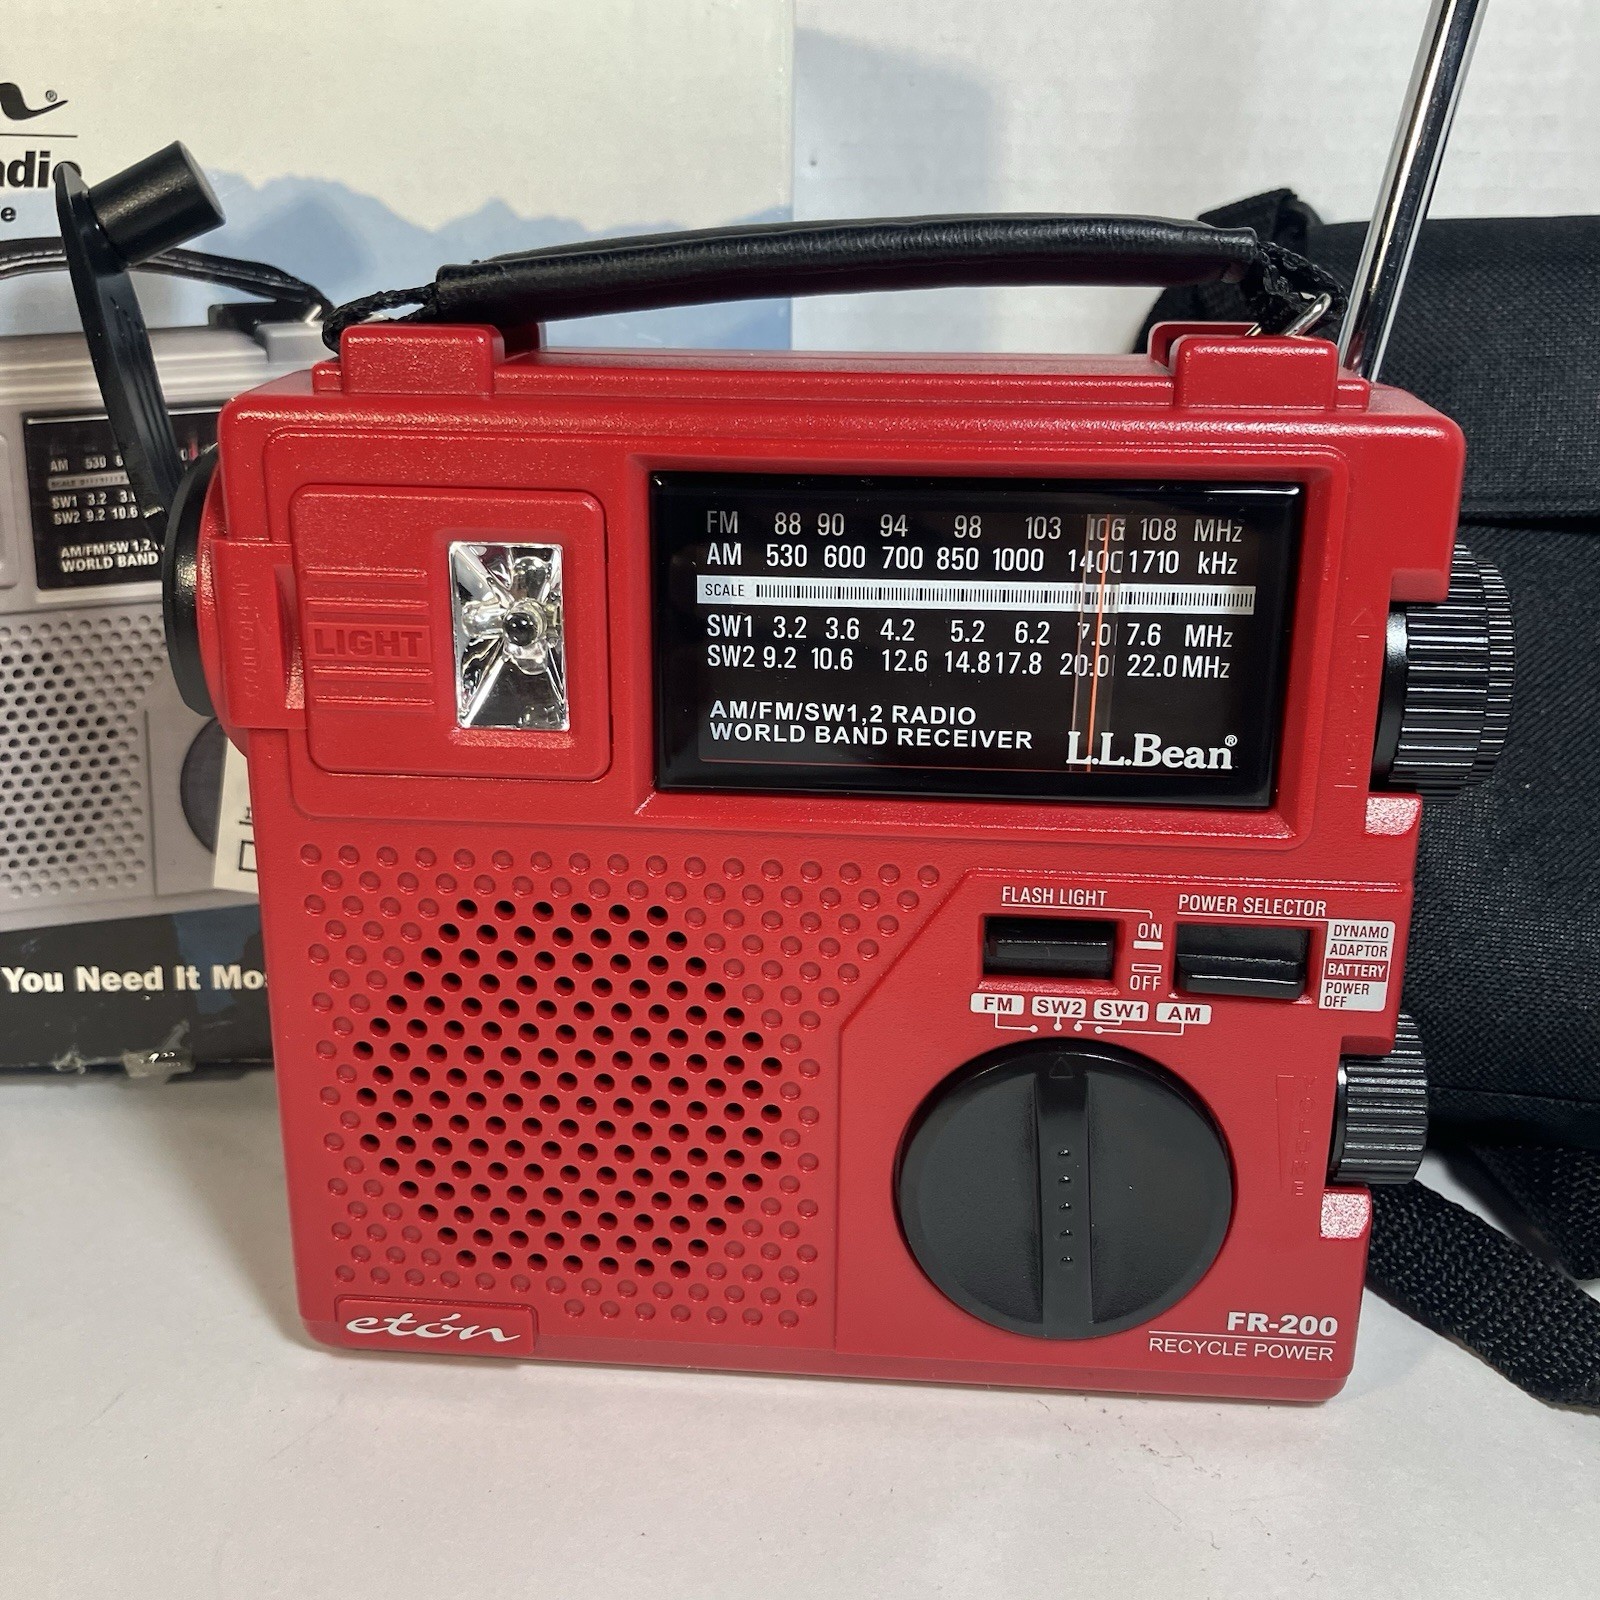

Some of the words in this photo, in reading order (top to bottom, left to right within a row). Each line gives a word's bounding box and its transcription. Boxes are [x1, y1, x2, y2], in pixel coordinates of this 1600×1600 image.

[50, 459, 69, 472] AM
[85, 455, 107, 470] 530
[52, 495, 78, 509] SW1
[87, 492, 107, 506] 3.2
[54, 511, 80, 525] SW2
[86, 508, 106, 522] 9.2
[111, 505, 138, 520] 10.6
[707, 511, 739, 534] FM
[775, 512, 801, 535] 88
[817, 513, 845, 536] 90
[880, 514, 908, 537] 94
[954, 515, 982, 538] 98
[1025, 516, 1062, 539] 103
[1140, 518, 1177, 541] 108
[1194, 519, 1243, 542] MHz
[61, 541, 129, 558] AM/FM/SW
[706, 542, 742, 565] AM
[766, 543, 807, 567] 530
[824, 544, 866, 568] 600
[882, 546, 923, 569] 700
[936, 547, 979, 570] 850
[992, 548, 1044, 571] 1000
[1129, 550, 1179, 573] 1710
[1197, 551, 1238, 574] kHz
[61, 556, 113, 573] WORLD
[117, 551, 159, 568] BAND
[705, 583, 745, 597] SCALE
[707, 614, 752, 638] SW1
[773, 616, 807, 639] 3.2
[825, 617, 860, 640] 3.6
[880, 618, 915, 642] 4.2
[950, 619, 985, 643] 5.2
[1014, 620, 1050, 644] 6.2
[1077, 621, 1111, 646] 7.0
[1127, 622, 1161, 646] 7.6
[1185, 624, 1233, 648] MHz
[313, 629, 423, 658] LIGHT
[707, 644, 755, 668] SW2
[763, 646, 797, 669] 9.2
[811, 647, 853, 670] 10.6
[882, 649, 928, 673] 12.6
[944, 649, 991, 674] 14.8
[995, 651, 1042, 675] 17.8
[1060, 653, 1109, 677] 20.0
[1127, 654, 1177, 678] 22.0
[1182, 655, 1229, 678] MHz
[709, 700, 883, 726] AM/FM/SW1,2
[892, 705, 976, 725] RADIO
[710, 722, 806, 743] WORLD
[815, 726, 888, 745] BAND
[897, 728, 1032, 749] RECEIVER
[1002, 886, 1054, 905] FLASH
[1058, 888, 1108, 906] LIGHT
[1179, 894, 1240, 913] POWER
[1243, 898, 1327, 917] SELECTOR
[1137, 923, 1162, 940] ON
[1333, 924, 1389, 939] DYNAMO
[1330, 942, 1388, 958] ADAPTOR
[0, 965, 64, 993] You
[76, 964, 164, 992] Need
[175, 965, 201, 990] It
[212, 964, 268, 990] Mo
[1328, 962, 1385, 979] BATTERY
[1129, 974, 1162, 991] OFF
[1325, 981, 1370, 996] POWER
[983, 997, 1013, 1012] FM
[1037, 999, 1082, 1015] SW2
[1324, 994, 1347, 1008] OFF
[1099, 1003, 1145, 1019] SW1
[1168, 1006, 1201, 1021] AM
[1227, 1312, 1338, 1336] FR-200
[1149, 1337, 1248, 1357] RECYCLE
[1254, 1343, 1333, 1361] POWER
